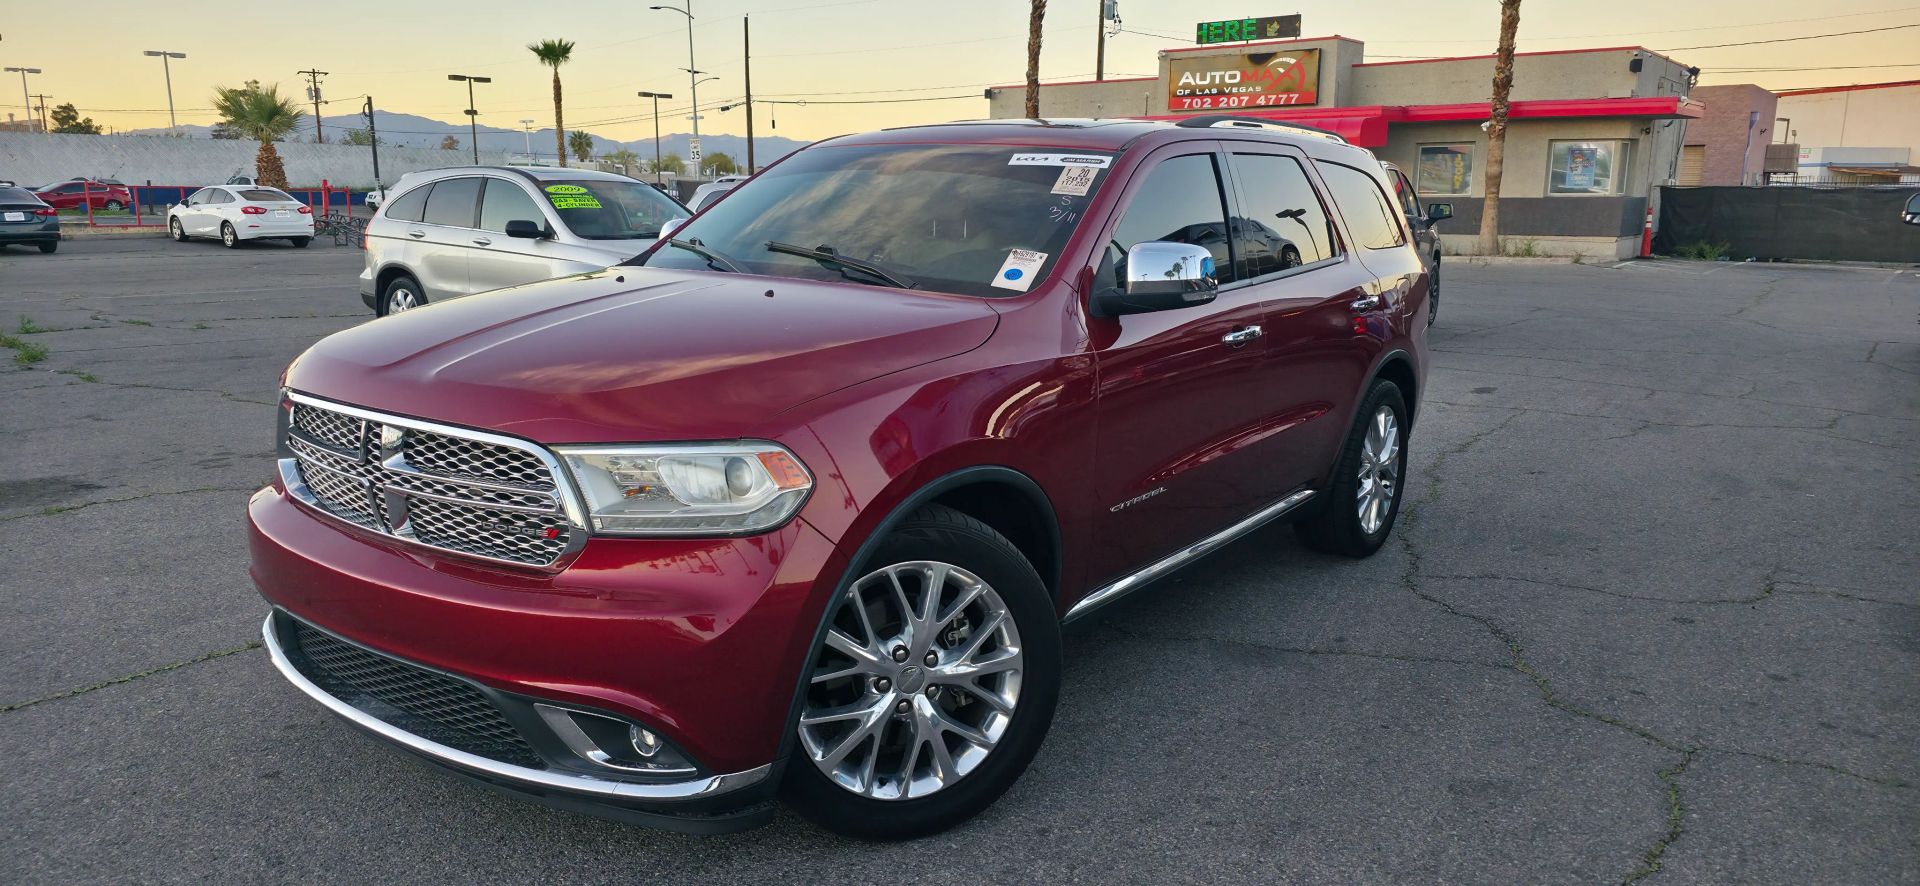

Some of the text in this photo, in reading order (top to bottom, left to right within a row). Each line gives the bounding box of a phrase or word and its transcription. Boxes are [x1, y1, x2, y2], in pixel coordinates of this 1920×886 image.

[1182, 93, 1300, 109] 702 207 4777
[691, 150, 701, 160] 35
[1078, 168, 1090, 178] 20
[1049, 206, 1076, 224] 3/11
[1109, 486, 1168, 512] CITADEL
[482, 521, 549, 537] DODGE
